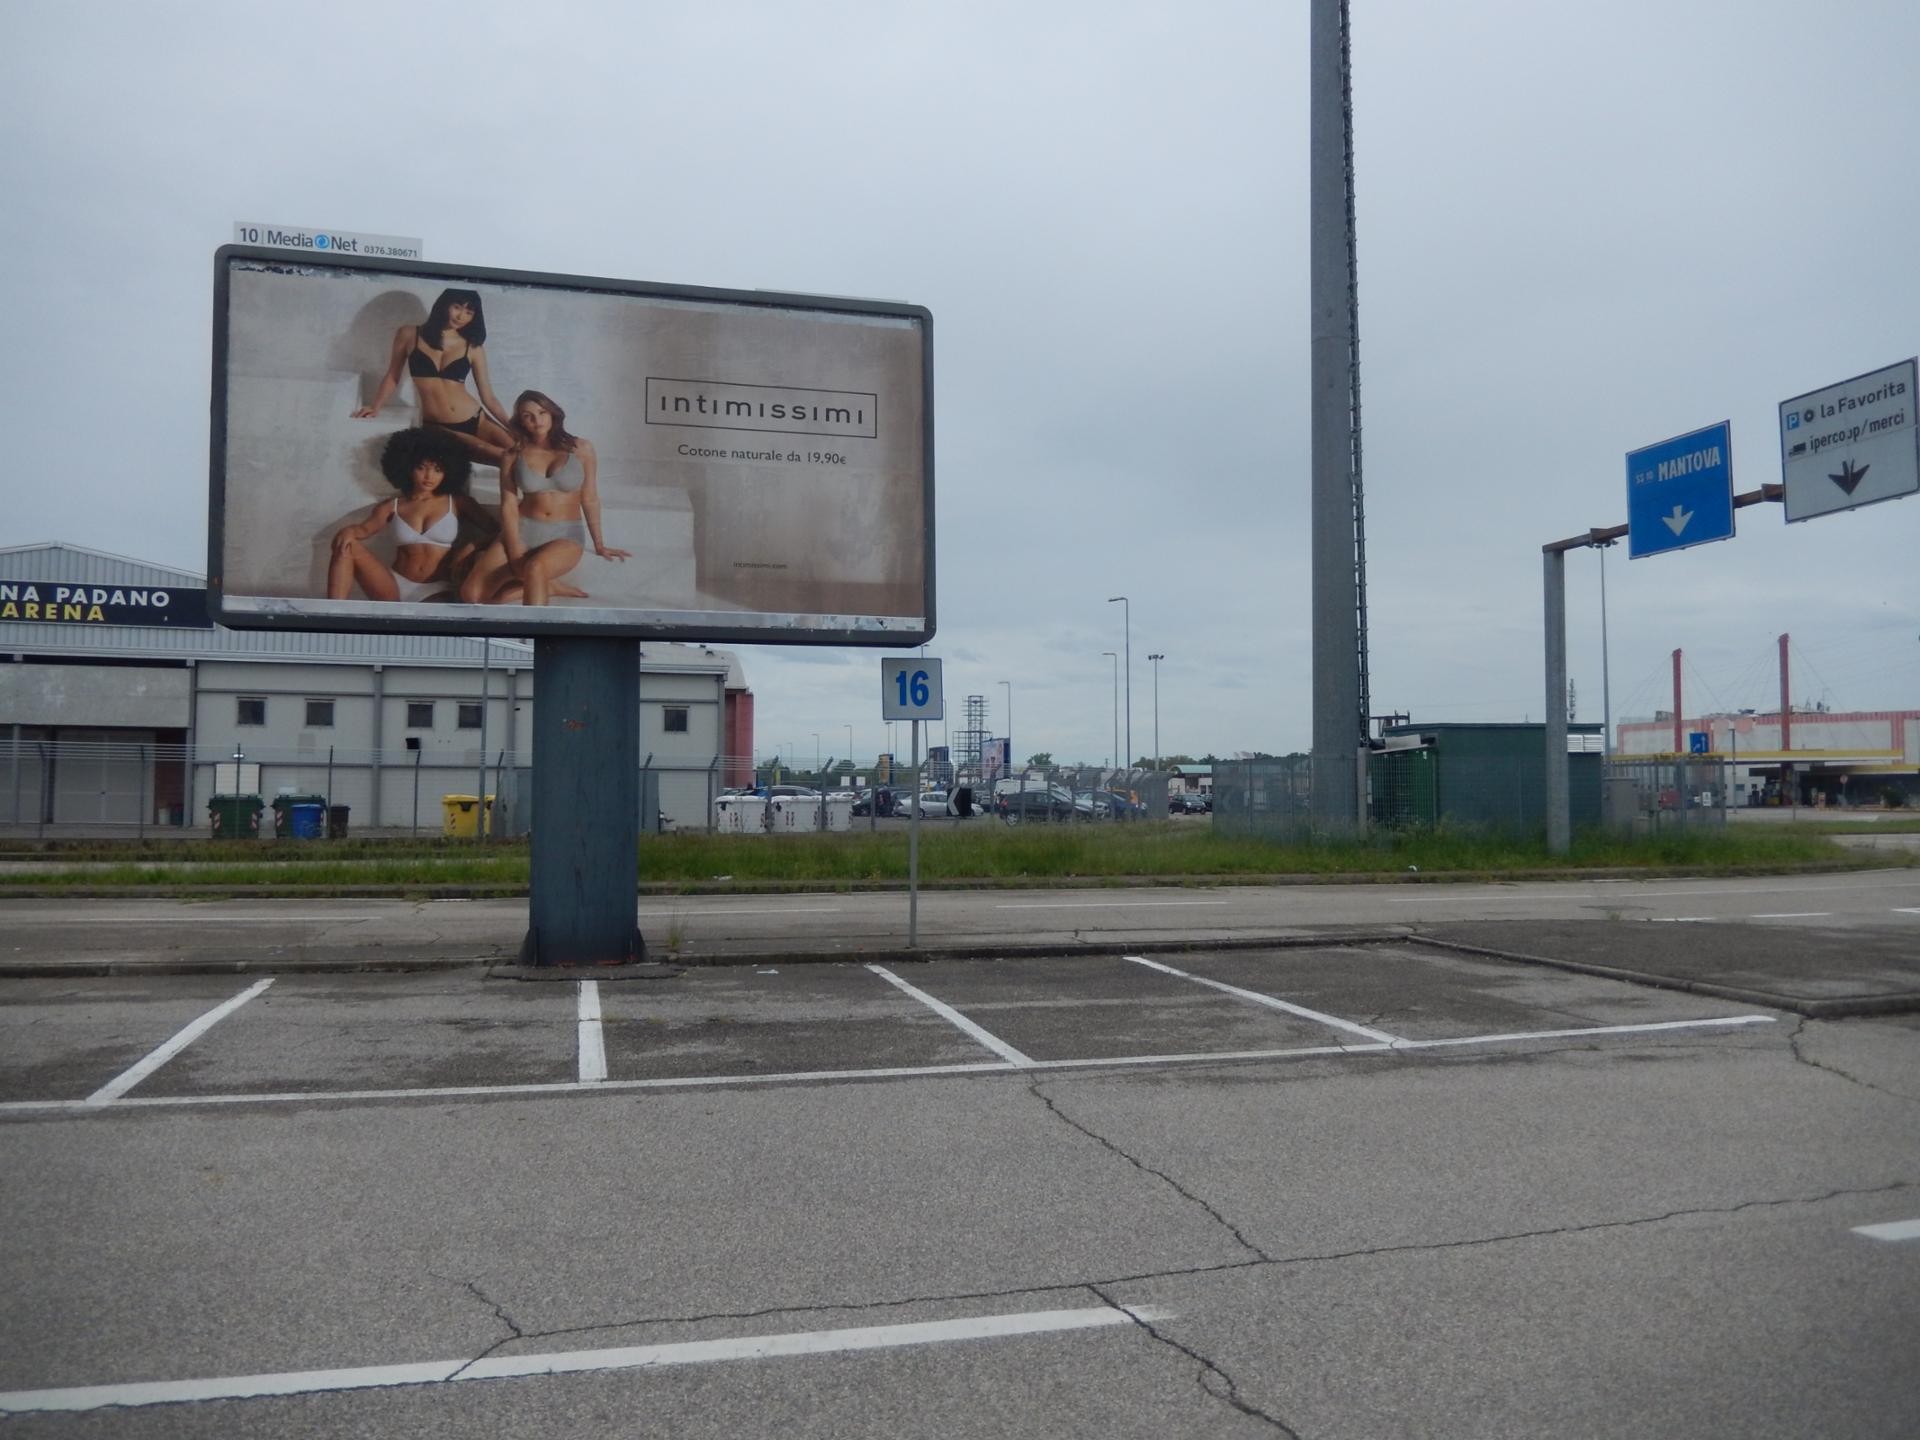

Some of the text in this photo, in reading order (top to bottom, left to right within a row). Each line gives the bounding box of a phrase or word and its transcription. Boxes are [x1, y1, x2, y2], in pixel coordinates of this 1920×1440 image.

[240, 227, 259, 244] 10
[661, 395, 863, 424] intimissimi
[1838, 382, 1906, 413] Favorita
[677, 444, 727, 458] Cotone
[731, 450, 783, 462] naturale
[787, 450, 801, 463] da
[1658, 446, 1721, 482] MANTOVA
[56, 587, 170, 608] PADANO
[1, 602, 105, 621] ARENA
[896, 670, 929, 707] 16
